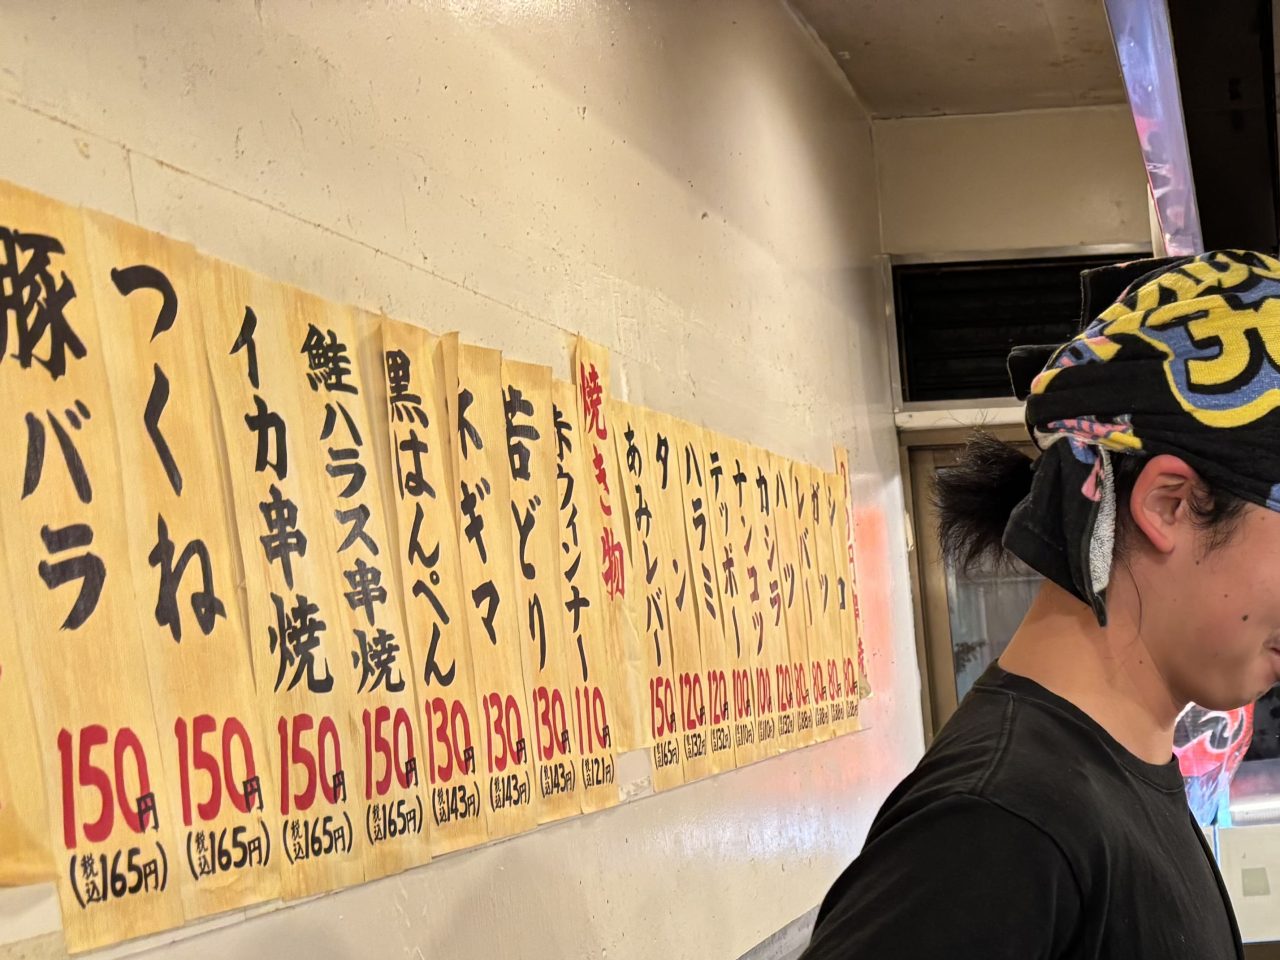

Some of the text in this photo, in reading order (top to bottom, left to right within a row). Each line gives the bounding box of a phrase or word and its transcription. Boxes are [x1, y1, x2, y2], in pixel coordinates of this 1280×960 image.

[0, 226, 107, 630] 豚バラ
[110, 263, 227, 644] つくね
[580, 360, 626, 601] 焼き物
[230, 305, 334, 694] イカ串焼
[300, 323, 406, 693] 鮭ハラス串焼
[386, 349, 456, 687] 黒はんぺん
[623, 421, 664, 668] あみレバー
[655, 432, 687, 613] タン
[684, 441, 717, 620] ハラミ
[732, 458, 764, 657] ナンコツ
[755, 465, 782, 627] カシラ
[775, 470, 795, 609] ハツ
[795, 475, 813, 627] レバー
[174, 713, 264, 827] 150円
[278, 712, 347, 816] 150円
[362, 705, 419, 801] 150円
[425, 697, 476, 785] 130円
[482, 692, 528, 774] 130円
[532, 686, 572, 763] 130円
[575, 685, 612, 756] 110円
[57, 723, 159, 850] 150円
[282, 811, 353, 865] (税込165円)
[366, 795, 424, 846] (税込165円)
[432, 780, 481, 827] (税込143円)
[489, 770, 531, 813] (税込143円)
[70, 841, 168, 910] (税込165円)
[187, 820, 271, 881] (税込165円)
